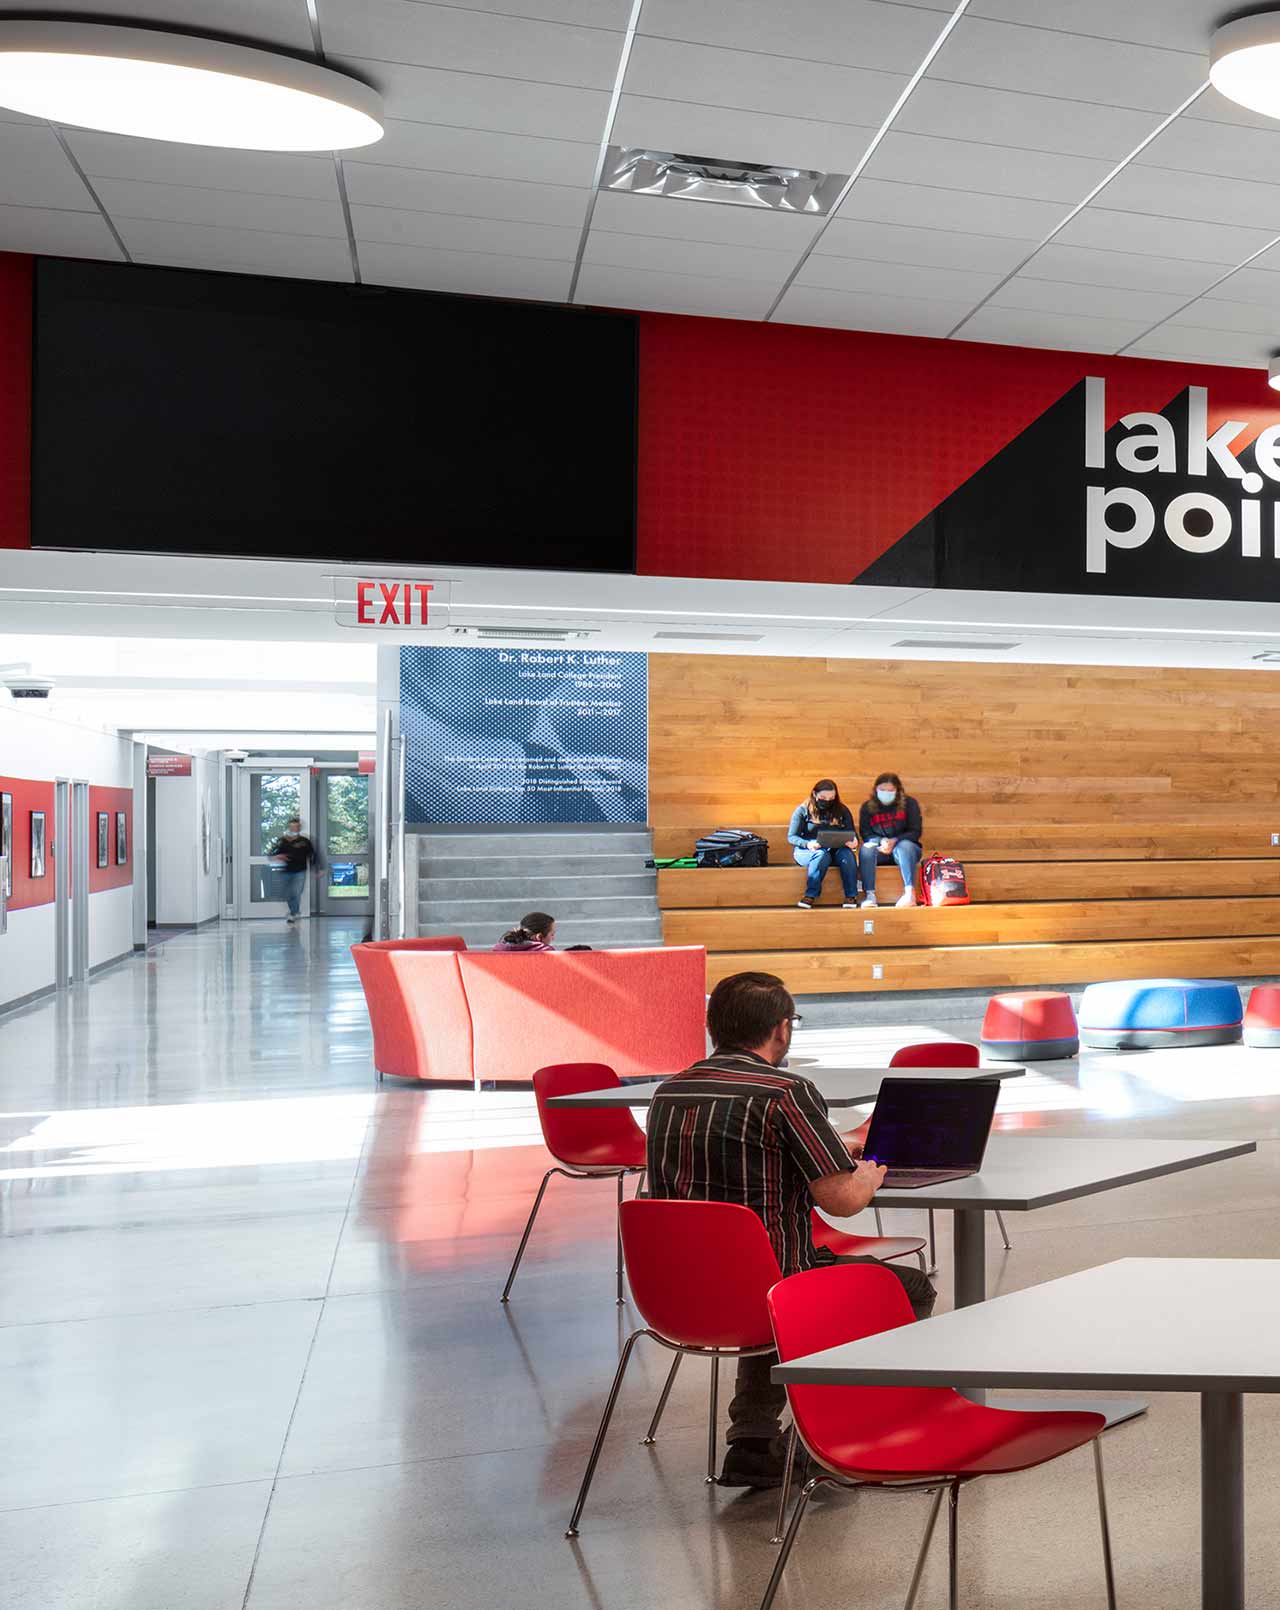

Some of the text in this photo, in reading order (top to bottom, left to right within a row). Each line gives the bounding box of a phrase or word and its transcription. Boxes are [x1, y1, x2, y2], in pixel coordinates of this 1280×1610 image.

[358, 582, 434, 625] EXIT
[499, 653, 622, 666] Dr. Robert K. Luther
